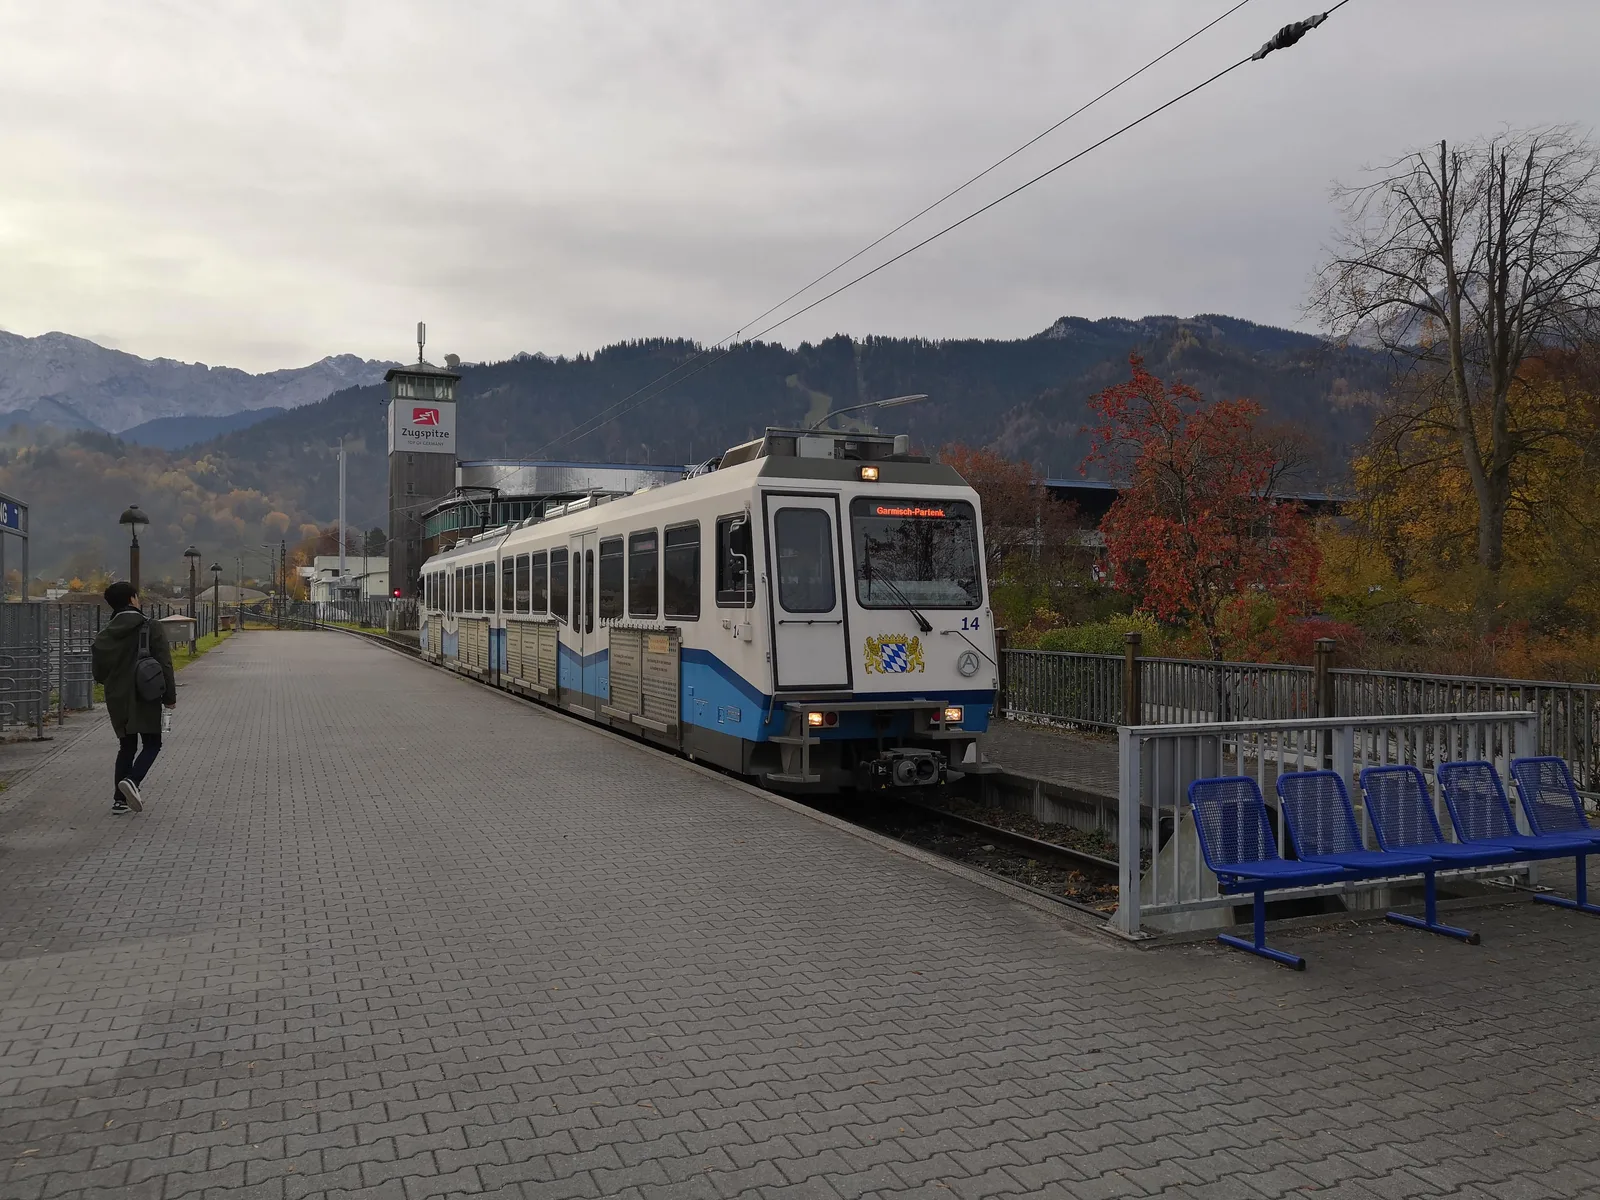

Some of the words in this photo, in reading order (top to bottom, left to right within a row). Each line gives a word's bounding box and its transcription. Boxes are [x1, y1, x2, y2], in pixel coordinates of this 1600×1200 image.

[402, 428, 450, 439] Zugspitze
[876, 506, 946, 517] Garmisch-Partenk.
[961, 617, 980, 631] 14
